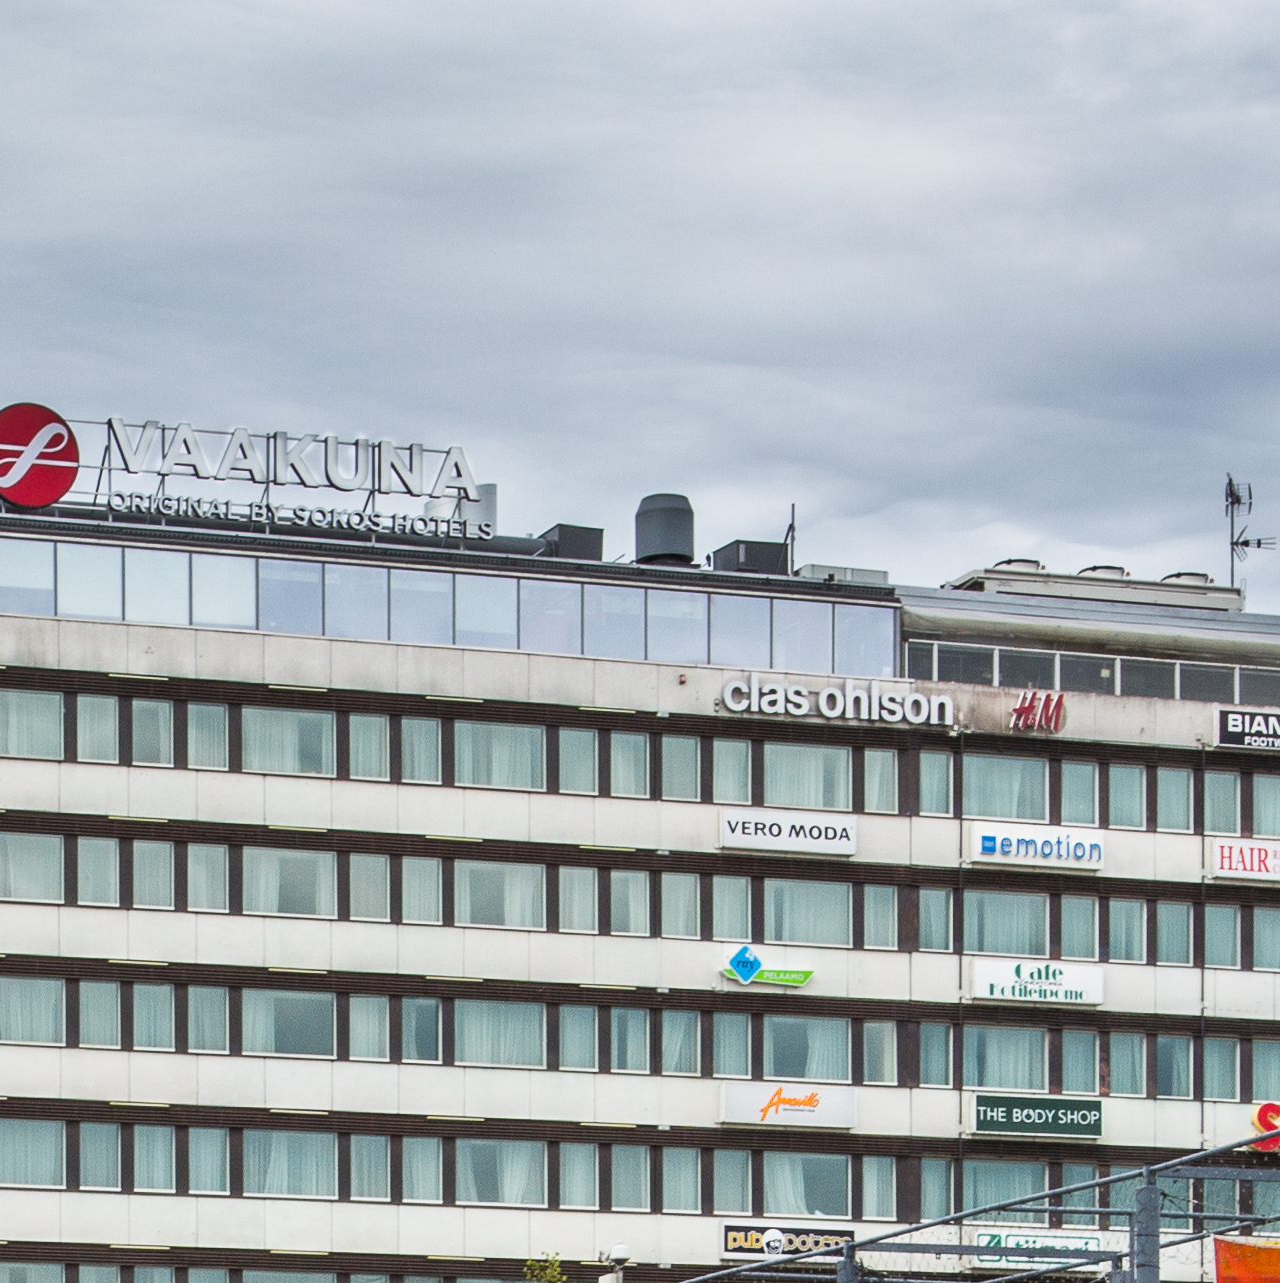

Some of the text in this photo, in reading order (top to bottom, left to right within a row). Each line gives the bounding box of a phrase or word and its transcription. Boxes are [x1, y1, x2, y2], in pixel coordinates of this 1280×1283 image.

[107, 418, 481, 502] VAAKUNA
[109, 490, 493, 541] ORIGINAL BY SOKOS HOTELS
[723, 671, 954, 726] clas ohlson
[1009, 691, 1064, 733] H&M
[727, 820, 851, 841] VERO MODA
[1000, 834, 1102, 861] emotion
[1219, 845, 1270, 873] HAIR
[736, 960, 755, 972] ray
[989, 983, 1088, 1000] Kotileipomo
[977, 1107, 1100, 1125] THE BODY SHOP
[727, 1231, 763, 1250] pub
